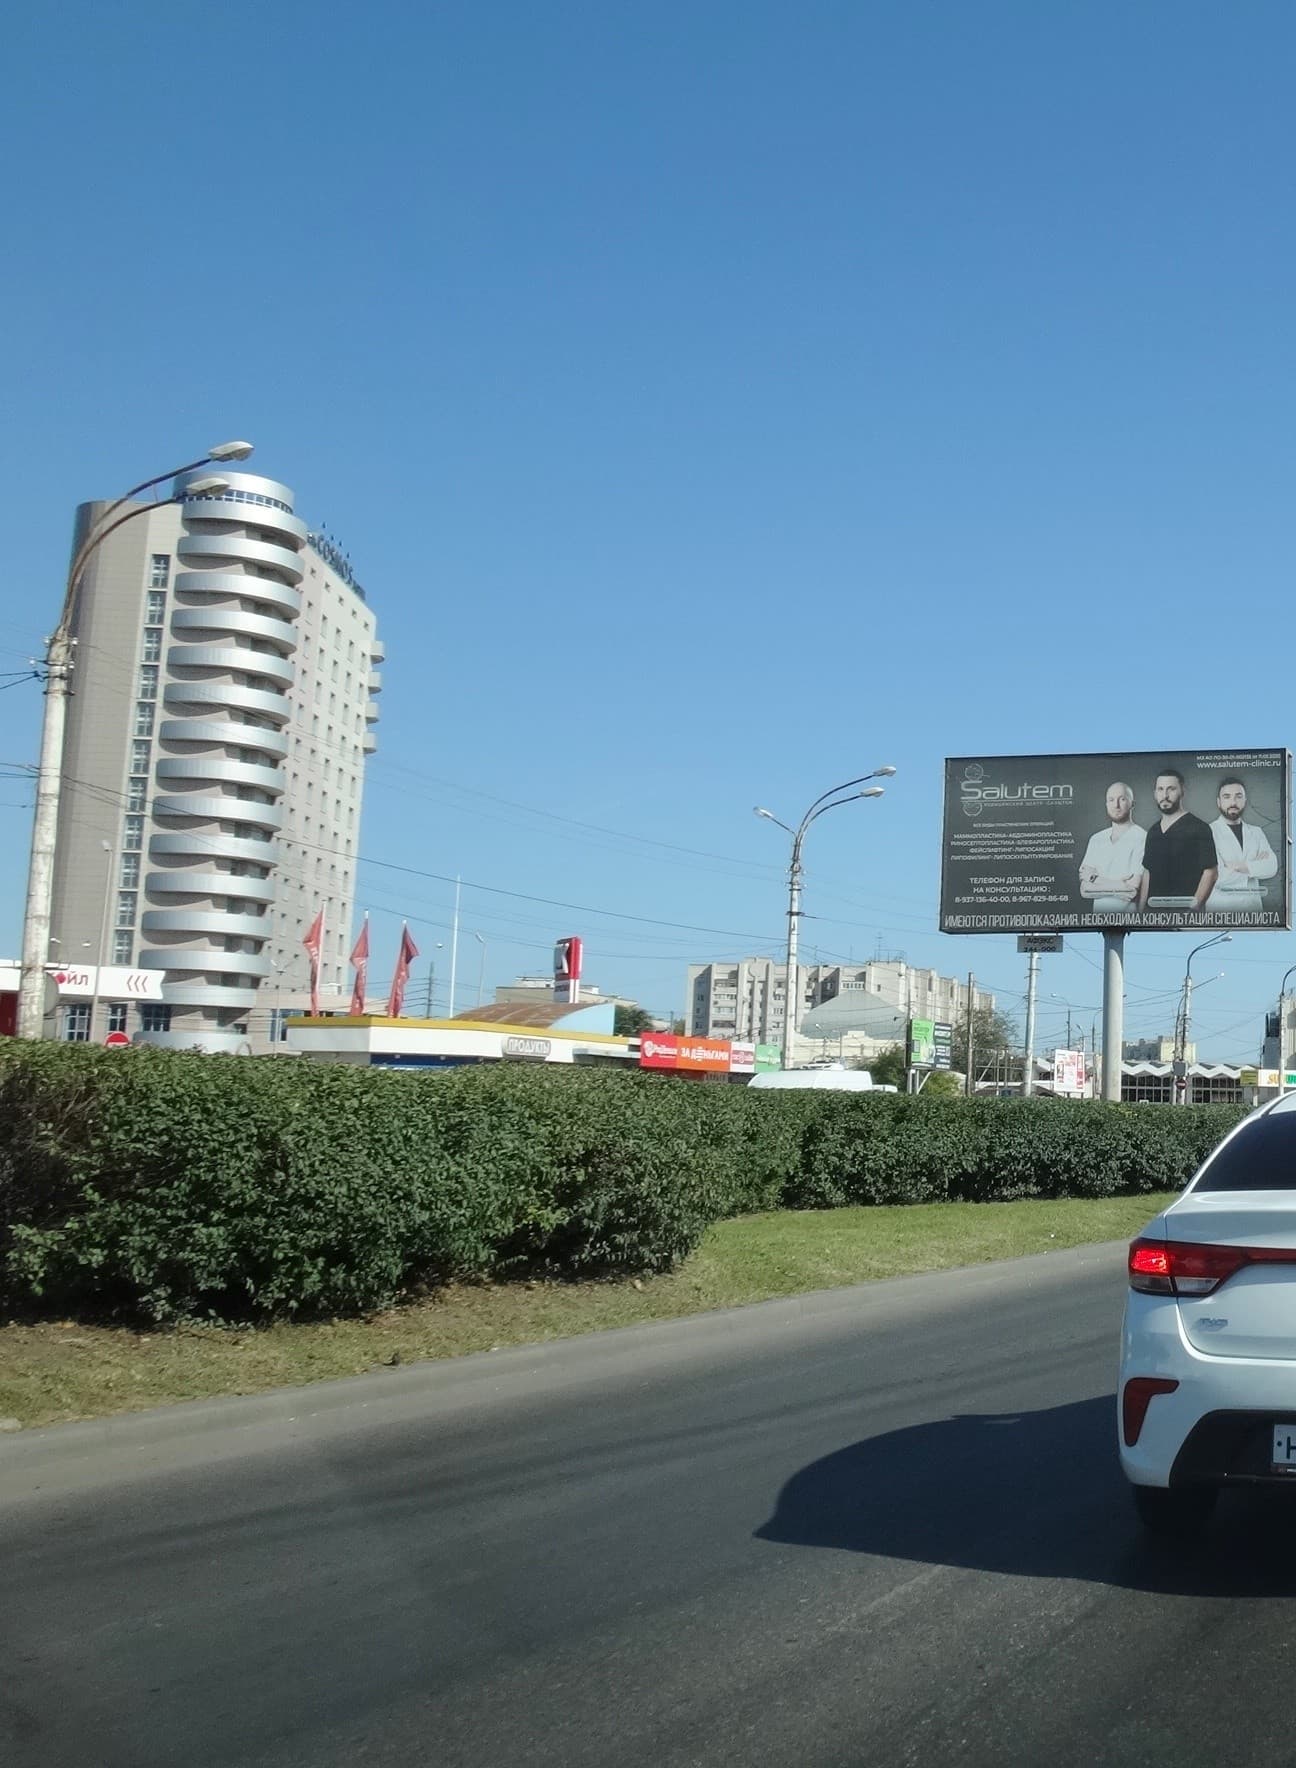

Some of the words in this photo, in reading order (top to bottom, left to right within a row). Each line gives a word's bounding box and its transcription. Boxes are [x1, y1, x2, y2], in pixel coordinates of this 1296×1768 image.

[1196, 760, 1281, 768] www.salutem-clinic.ru
[960, 780, 1073, 800] Salutem
[969, 877, 1005, 885] ТЕЛЕФОН
[1023, 876, 1055, 884] ЗАПИСИ
[944, 914, 988, 928] ИМЕЮТСЯ
[1081, 912, 1141, 926] НЕОБХОДИМА
[1142, 911, 1215, 926] КОНСУЛЬТАЦИЯ
[1215, 911, 1280, 925] СПЕЦИАЛИСТА
[508, 1038, 550, 1053] ПРОДУКТЫ
